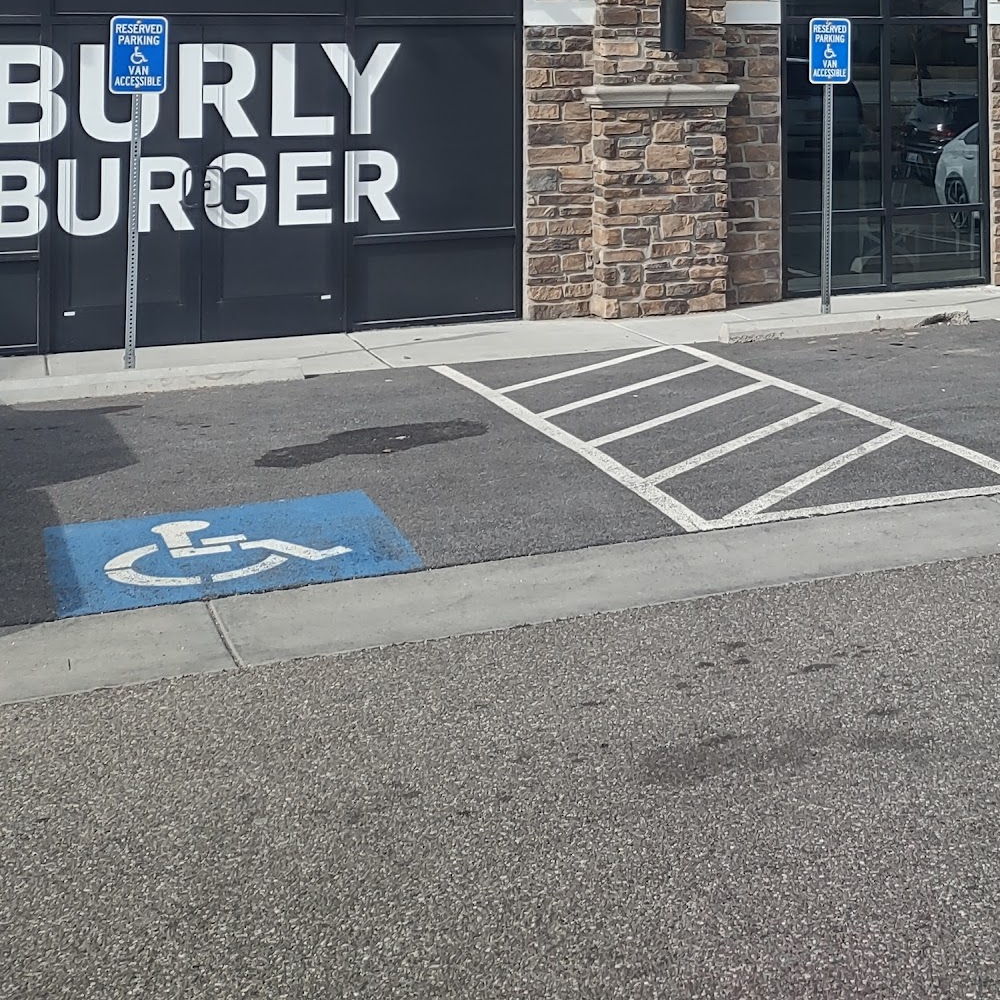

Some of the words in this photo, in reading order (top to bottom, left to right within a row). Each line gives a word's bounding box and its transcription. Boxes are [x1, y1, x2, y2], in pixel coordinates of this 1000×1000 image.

[115, 23, 163, 34] RESERVED
[813, 24, 847, 34] RESERVED
[118, 35, 160, 46] PARKING
[815, 33, 846, 43] PARKING
[822, 59, 838, 68] VAN
[128, 65, 149, 76] VAN
[812, 68, 847, 78] ACCESSIBLE
[114, 76, 162, 87] ACCESSIBLE
[0, 43, 401, 143] BURLY
[0, 150, 401, 238] BURGER
